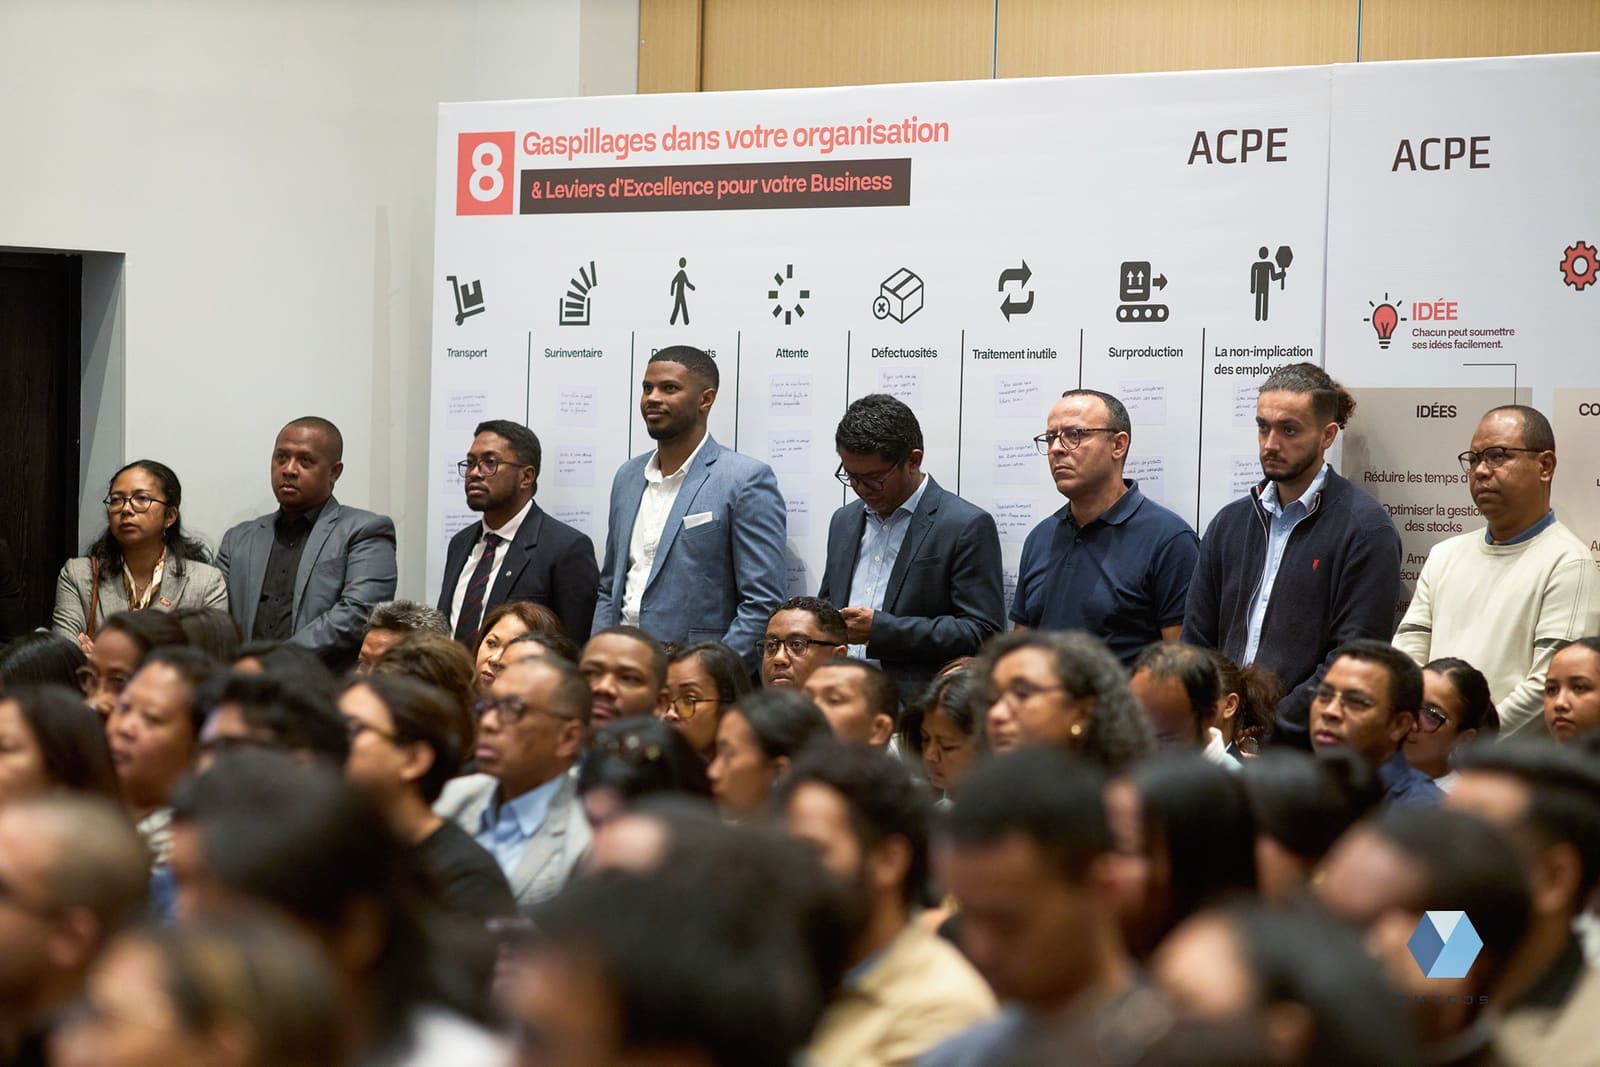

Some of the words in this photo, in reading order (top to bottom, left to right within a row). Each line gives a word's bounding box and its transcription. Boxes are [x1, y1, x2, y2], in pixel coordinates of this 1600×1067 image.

[522, 127, 656, 161] Gaspillages
[661, 125, 721, 152] dans
[725, 124, 789, 150] votre
[792, 115, 950, 155] organisation
[1187, 127, 1289, 166] ACPE
[1391, 135, 1491, 173] ACPE
[469, 142, 504, 202] 8
[531, 179, 543, 199] &
[545, 178, 606, 199] Leviers
[608, 175, 715, 198] d'Excellence
[717, 176, 759, 200] pour
[761, 173, 807, 195] votre
[811, 171, 893, 194] Business
[1412, 297, 1458, 321] IDÉE
[1411, 327, 1447, 337] Chacun
[1448, 327, 1468, 339] peut
[1469, 327, 1516, 337] soumettre
[1411, 341, 1428, 349] ses
[1429, 339, 1453, 349] idées
[1454, 338, 1504, 349] facilement.
[446, 347, 488, 360] Transport
[544, 347, 604, 359] Surinventaire
[775, 347, 809, 359] Attente
[871, 346, 938, 359] Défectuosités
[972, 347, 1025, 360] Traitement
[1026, 347, 1058, 360] inutile
[1108, 345, 1184, 360] Surproduction
[1214, 345, 1229, 357] La
[1229, 344, 1314, 360] non-implication
[1214, 363, 1234, 375] des
[1236, 362, 1281, 378] employé
[1416, 401, 1458, 419] IDÉES
[1364, 470, 1405, 483] Réduire
[1407, 470, 1424, 483] les
[1424, 472, 1460, 486] temps
[1436, 504, 1446, 516] la
[1447, 504, 1482, 519] gestio
[1404, 520, 1425, 532] des
[1426, 521, 1463, 533] stocks
